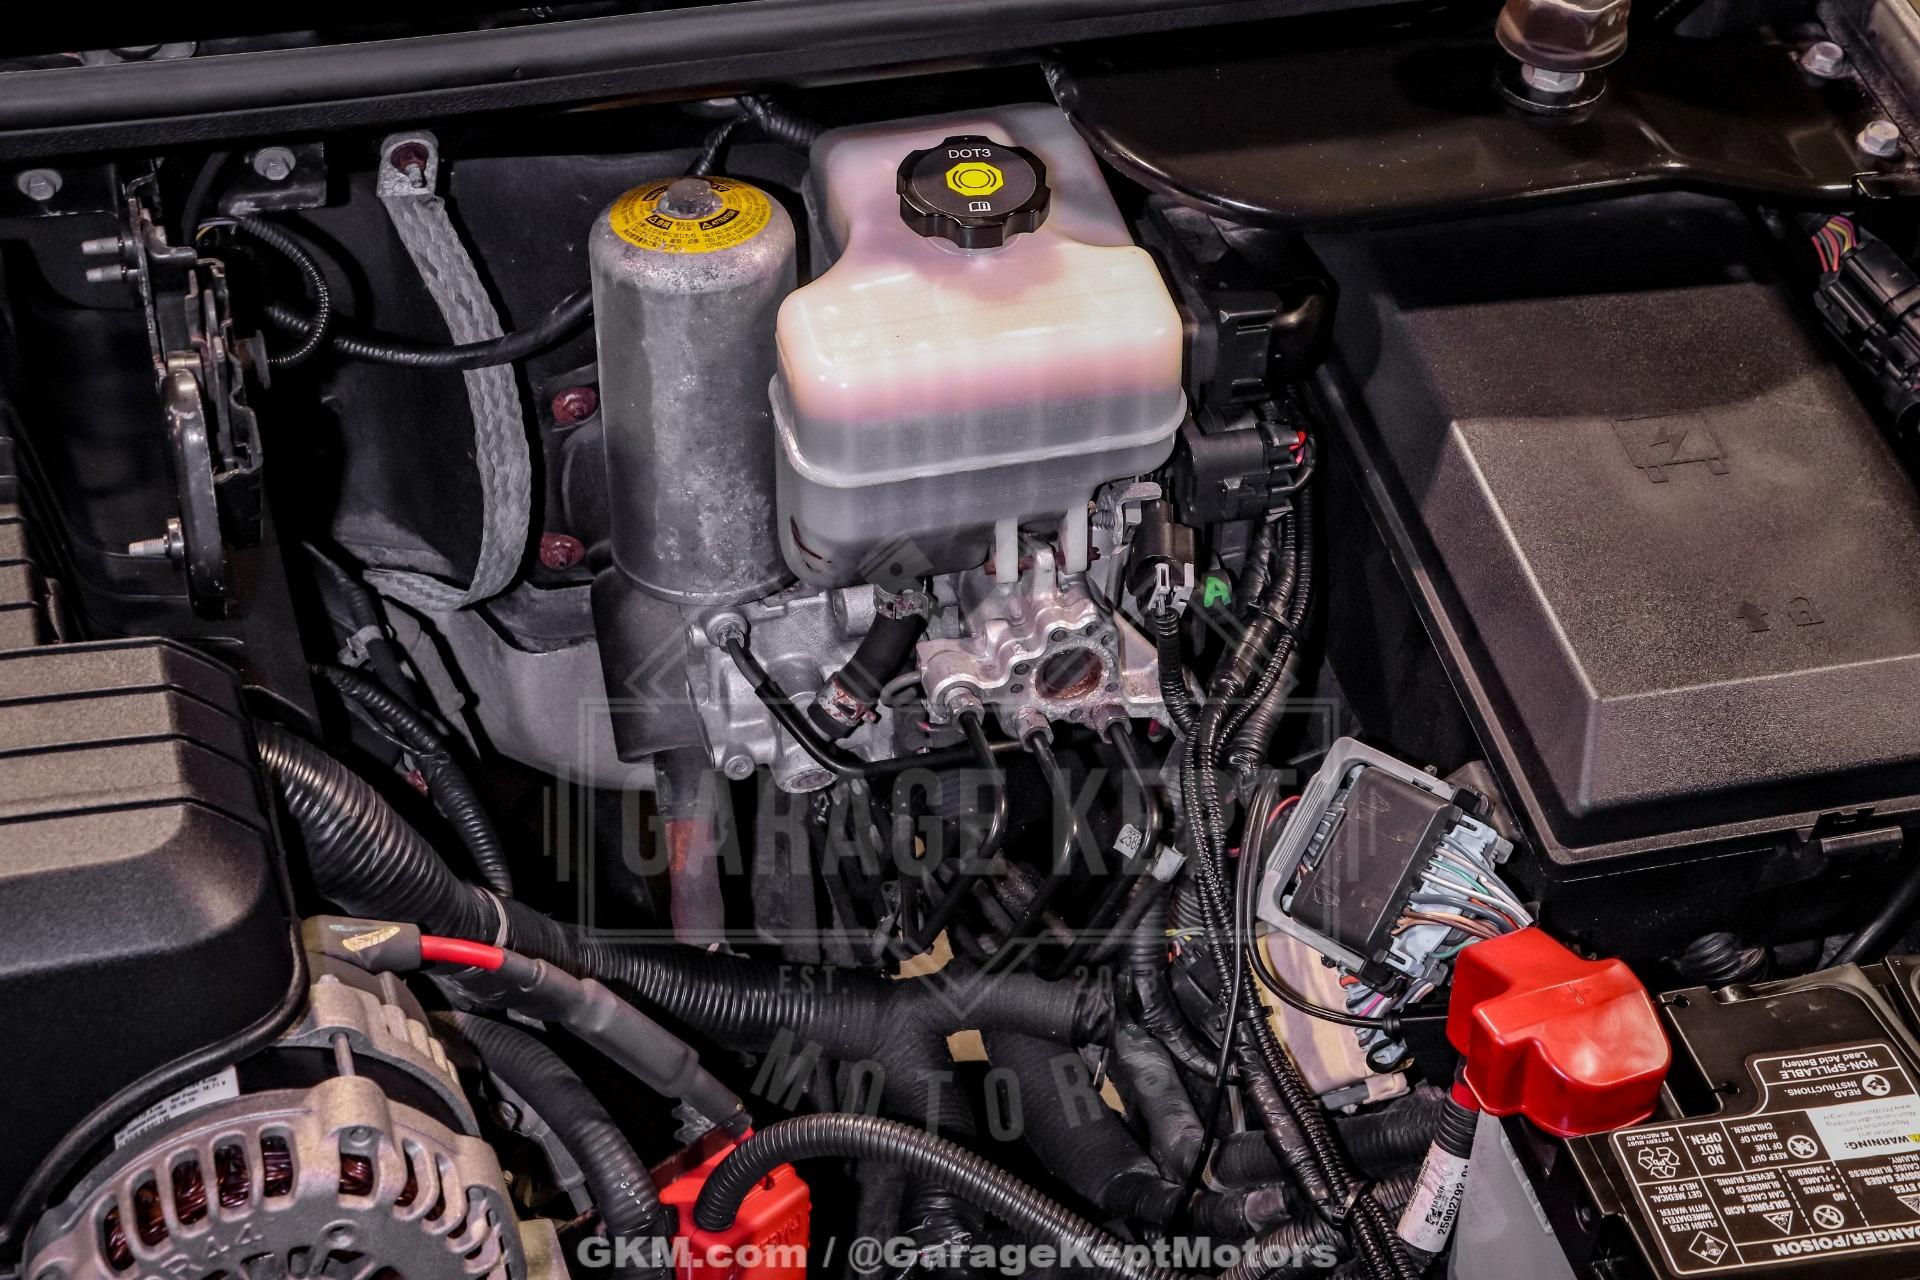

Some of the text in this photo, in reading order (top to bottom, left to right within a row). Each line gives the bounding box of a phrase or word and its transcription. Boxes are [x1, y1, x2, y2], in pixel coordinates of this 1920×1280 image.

[948, 148, 991, 159] DOT3
[711, 210, 736, 226] ATTENTION
[1782, 1051, 1868, 1068] Lead Acid Battery
[1779, 1058, 1878, 1079] NON-SPILLABLE
[1784, 1080, 1858, 1096] INSTRUCTIONS.
[1834, 1088, 1861, 1098] READ
[1730, 1122, 1773, 1134] CHILDREN.
[1626, 1132, 1659, 1141] RECYCLED
[1645, 1136, 1674, 1145] BATTERY
[1686, 1132, 1722, 1145] OPEN.
[1740, 1132, 1778, 1143] REACH OF
[1699, 1143, 1724, 1155] NOT
[1754, 1142, 1782, 1152] OF THE
[1844, 1136, 1910, 1150] WARNING:
[1707, 1155, 1726, 1166] DO
[1750, 1152, 1788, 1163] KEEP OUT
[1788, 1165, 1825, 1177] SMOKING
[1848, 1162, 1920, 1178] CAUSE BLINDNESS
[1714, 1172, 1776, 1186] SEVERE BURNS.
[1798, 1174, 1830, 1185] FLAMES
[1864, 1174, 1894, 1186] GASES
[1655, 1182, 1699, 1194] HELP FAST.
[1722, 1181, 1780, 1195] BLINDNESS OR
[1803, 1184, 1835, 1194] SPARKS
[1650, 1190, 1702, 1203] GET MEDICAL
[1740, 1190, 1785, 1202] CAN CAUSE
[1833, 1191, 1847, 1201] NO
[1437, 1182, 1464, 1235] 25902792
[1656, 1203, 1710, 1216] WITH WATER.
[1724, 1199, 1790, 1215] SULFURIC ACID
[1662, 1212, 1714, 1225] IMMEDIATELY
[1670, 1220, 1718, 1232] FLUSH EYES
